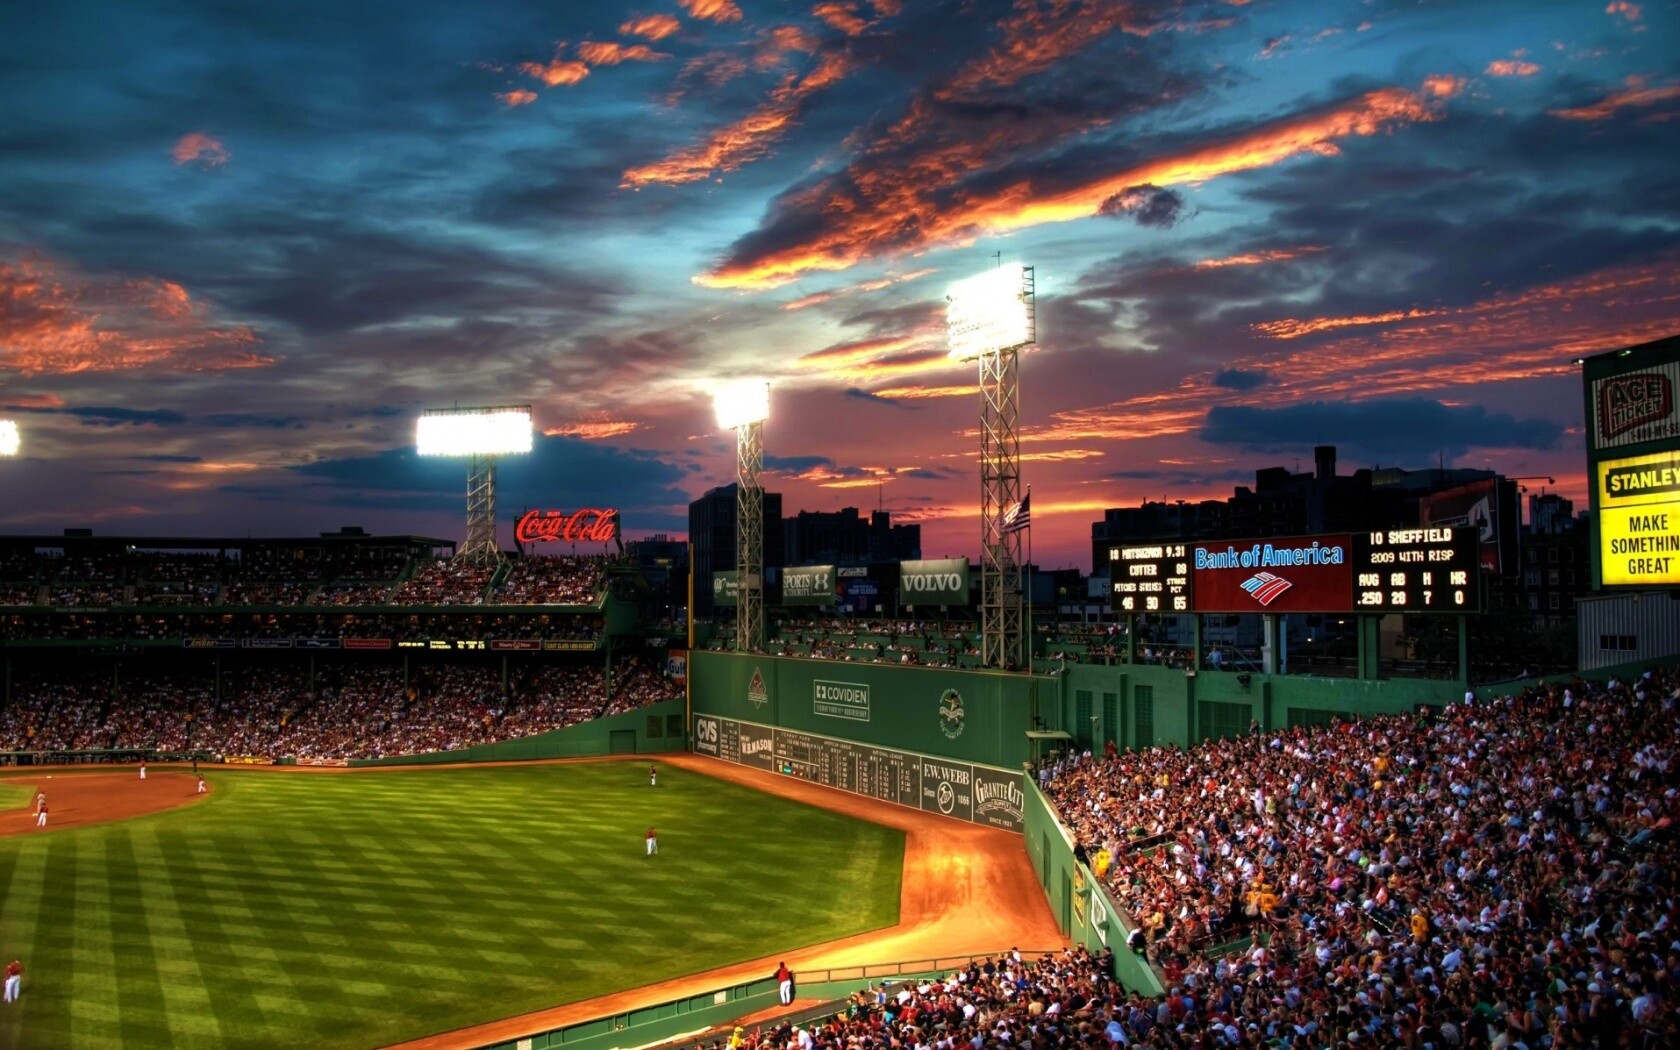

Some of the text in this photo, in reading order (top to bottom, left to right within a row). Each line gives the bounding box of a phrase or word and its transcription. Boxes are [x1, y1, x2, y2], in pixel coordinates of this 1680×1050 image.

[1613, 381, 1662, 406] ACE
[1613, 401, 1662, 428] TICKET
[1611, 467, 1680, 492] STANLEY
[516, 508, 618, 542] Coca-Cola
[1629, 514, 1668, 532] MAKE
[1370, 528, 1452, 545] 10 SHEFFIELD
[1611, 535, 1680, 554] SOMETHIN
[1166, 546, 1185, 558] 9.31
[1195, 541, 1343, 569] Bank of America
[1371, 550, 1454, 563] 2009 WITH RISP
[1129, 564, 1157, 576] CUTTER
[1628, 558, 1670, 574] GREAT
[783, 574, 810, 588] SPORTS
[902, 573, 962, 591] VOLVO
[1359, 571, 1466, 586] AVG AB H HR
[1114, 583, 1136, 592] PITCHES
[1174, 596, 1186, 610] 65
[1357, 591, 1382, 605] .250
[1423, 591, 1432, 605] 7
[1454, 590, 1464, 605] 0
[828, 687, 867, 703] COVIDIEN
[697, 719, 717, 743] CVS
[941, 766, 970, 785] WEBB
[924, 787, 935, 797] Since
[975, 778, 1007, 803] GRANITE
